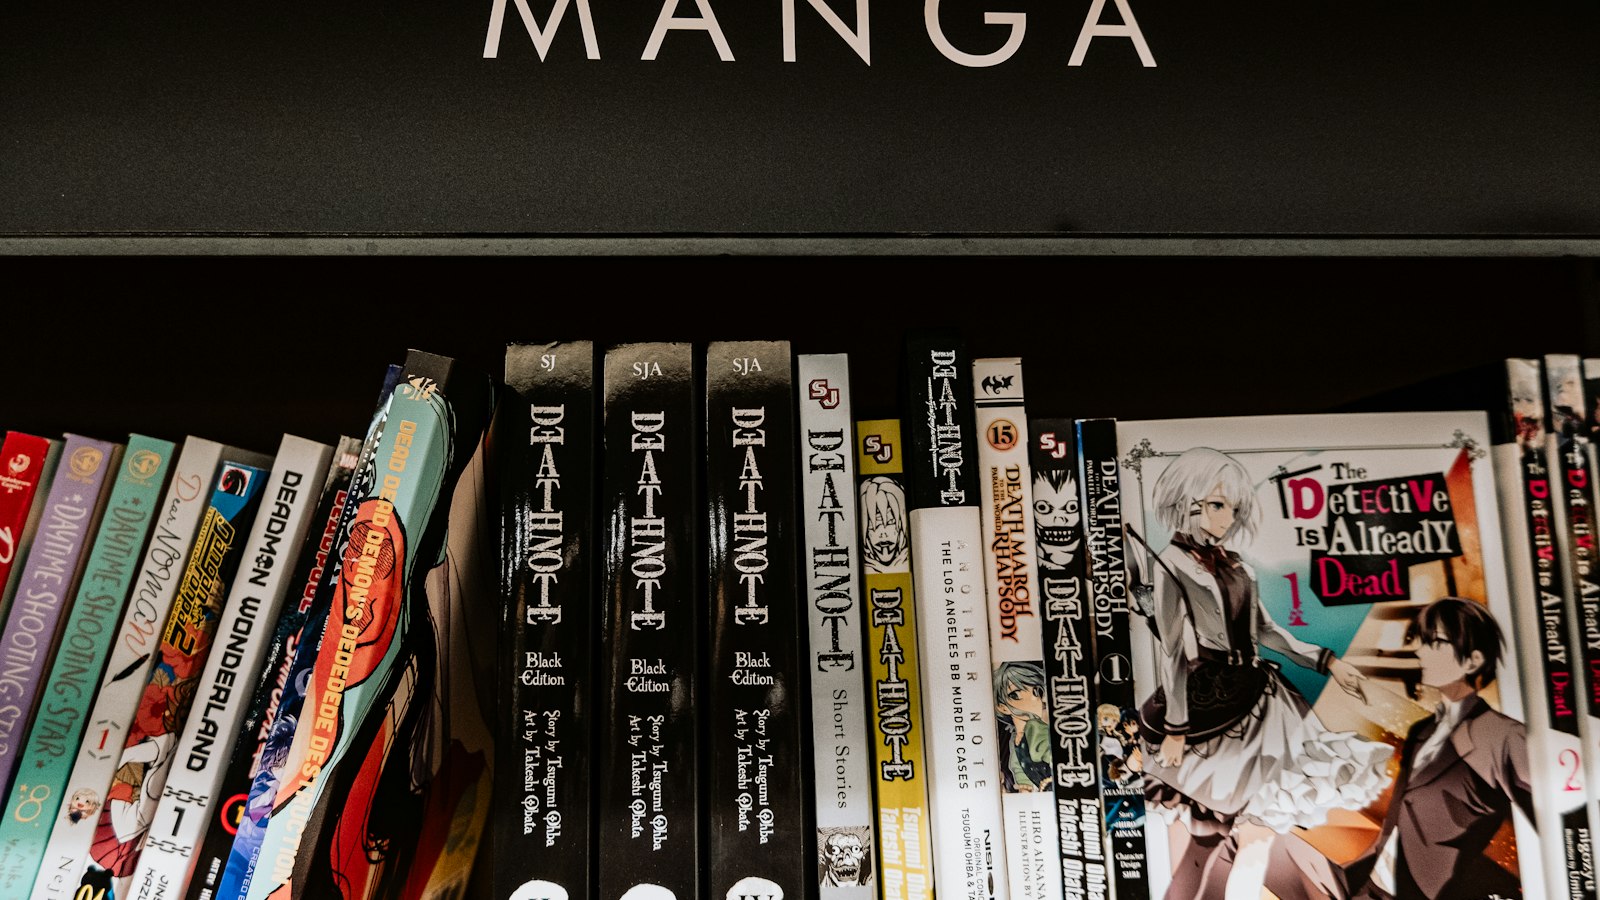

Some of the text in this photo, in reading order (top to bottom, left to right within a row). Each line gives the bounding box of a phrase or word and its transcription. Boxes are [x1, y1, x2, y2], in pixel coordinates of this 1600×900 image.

[483, 0, 1157, 67] MANGA
[541, 354, 556, 371] SJ
[633, 362, 663, 380] SJA
[733, 358, 762, 375] SJA
[809, 379, 840, 409] SJ
[388, 419, 417, 474] DEAD
[863, 434, 893, 464] SJ
[991, 425, 1013, 444] 15
[1040, 433, 1067, 458] SJ
[991, 466, 1002, 531] PARALLEL WORLD
[1331, 463, 1367, 480] The
[372, 474, 401, 528] DEAD
[34, 504, 87, 585] DAYTIME
[92, 505, 147, 588] DAYTIME
[1000, 464, 1033, 617] DEATH MARCH
[1097, 457, 1129, 614] DEATH MARCH
[345, 529, 385, 621] DEMON'S
[991, 530, 1020, 644] RHAPSODY
[1088, 526, 1115, 640] RHAPSODY
[1283, 572, 1309, 626] 1
[1316, 557, 1405, 597] Dead
[0, 588, 58, 699] SHOOTING
[54, 591, 117, 699] SHOOTING
[525, 652, 562, 668] Black
[630, 658, 667, 675] Black
[734, 652, 771, 668] Black
[941, 540, 969, 790] THE LOS ANGELES BB MURDER CASES
[186, 597, 261, 772] WONDERLAND
[315, 624, 360, 732] DEDEDEDE
[518, 670, 565, 686] Edition
[623, 676, 670, 692] Edition
[728, 670, 774, 685] Edition
[1551, 672, 1573, 716] Dead
[34, 703, 80, 758] STAR
[98, 729, 110, 750] 1
[832, 689, 852, 809] Short Stories
[970, 712, 986, 789] NOTE
[521, 710, 541, 835] Art by Takeshi Obata
[542, 710, 563, 847] Story by Tsugumi Ohba
[628, 714, 647, 839] Art by Takeshi Obata
[647, 714, 668, 851] Story by Tsugumi Ohba
[734, 709, 753, 832] Art by Takeshi Obata
[753, 709, 775, 845] Story by Tsugumi Ohba
[1558, 749, 1582, 791] 2
[171, 806, 186, 837] 1
[272, 735, 330, 883] DESTRUCTION
[880, 807, 902, 865] Takeshi
[961, 808, 973, 851] TSUGUMI
[1058, 799, 1082, 856] Takeshi
[1080, 799, 1104, 860] Tsugumi
[902, 807, 925, 870] Tsugumi
[965, 852, 974, 879] OHBA
[973, 837, 984, 877] ORIGINAL
[1018, 811, 1030, 882] ILLUSTRATION
[1031, 810, 1047, 900] HIRO AINANA
[241, 845, 260, 893] CREATED
